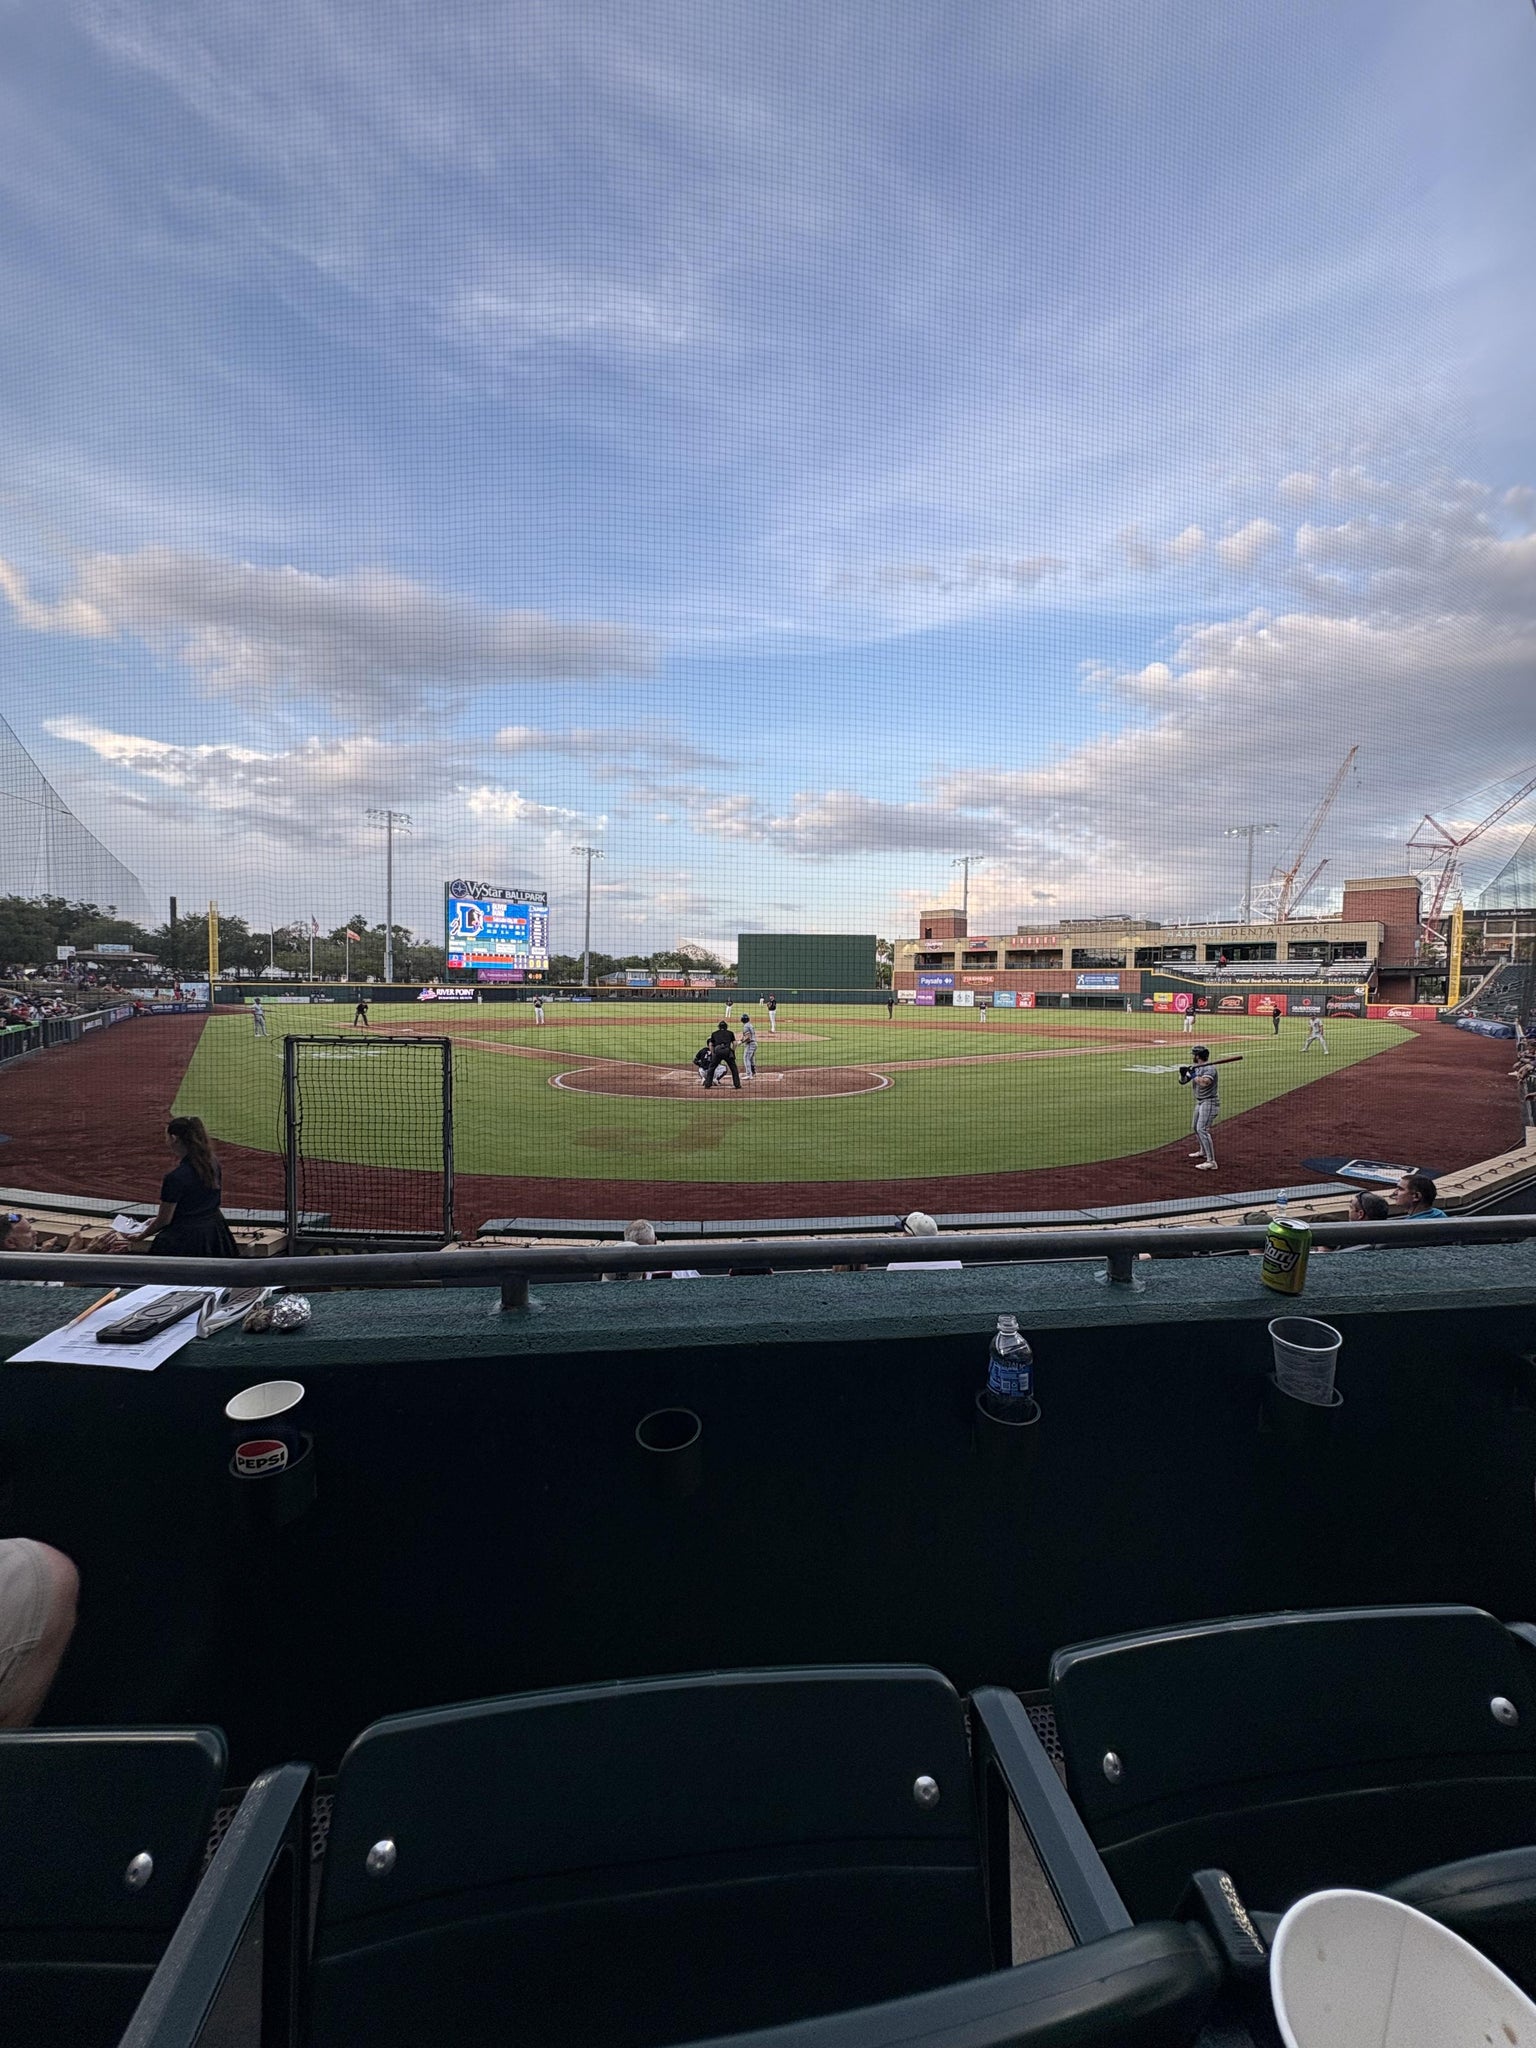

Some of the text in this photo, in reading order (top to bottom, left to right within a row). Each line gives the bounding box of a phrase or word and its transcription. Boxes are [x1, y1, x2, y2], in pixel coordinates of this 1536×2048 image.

[466, 882, 546, 902] VyStar BALLPARK
[1167, 925, 1330, 938] HARBOUR DENTAL CARE
[920, 977, 942, 985] Paysafe
[237, 1451, 285, 1468] PEPSI
